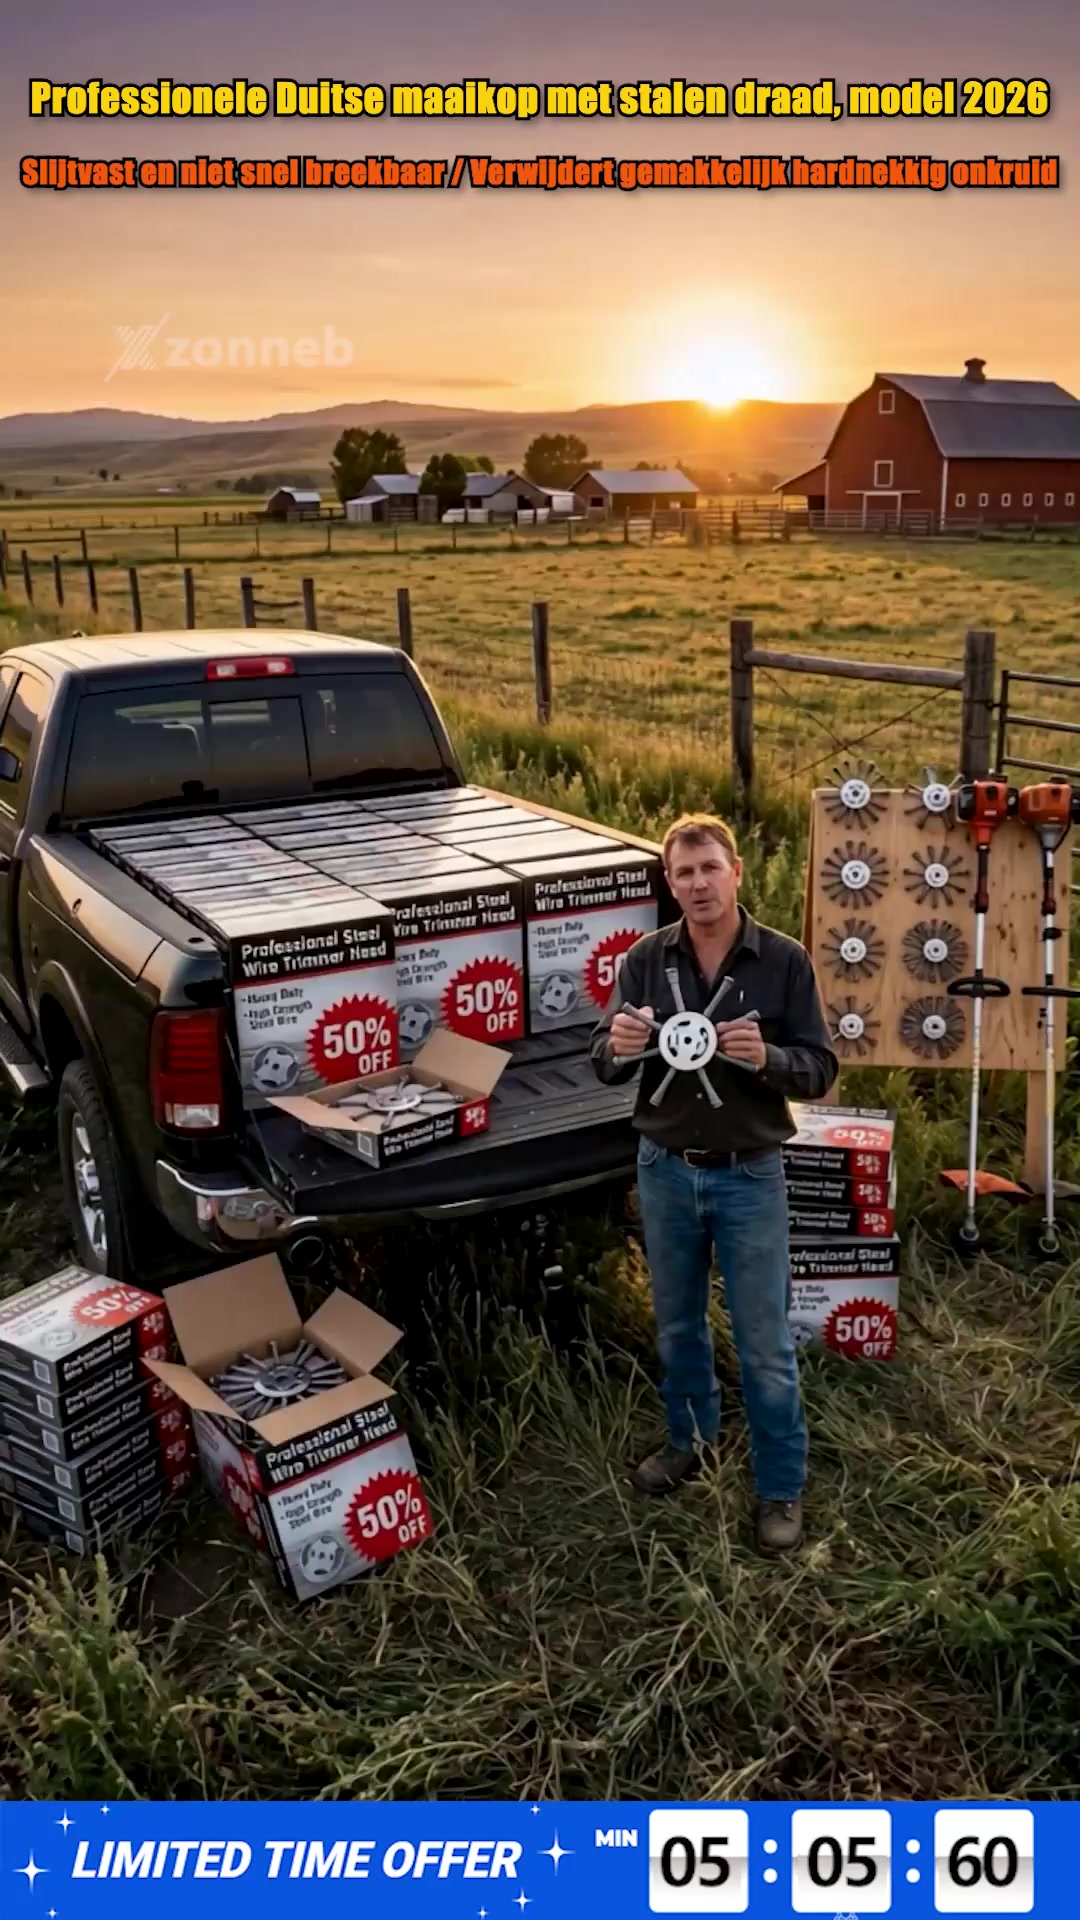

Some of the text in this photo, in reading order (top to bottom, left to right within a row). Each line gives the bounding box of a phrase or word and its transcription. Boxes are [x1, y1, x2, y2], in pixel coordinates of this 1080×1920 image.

[241, 929, 339, 961] Professional
[456, 977, 518, 1017] 50%
[487, 1009, 519, 1033] OFF
[323, 1015, 391, 1059] 50%
[358, 1049, 393, 1075] OFF
[80, 1288, 141, 1320] 50%
[835, 1314, 893, 1343] 50%
[863, 1341, 893, 1357] OFF
[357, 1483, 422, 1540] 50%
[398, 1514, 428, 1545] OFF
